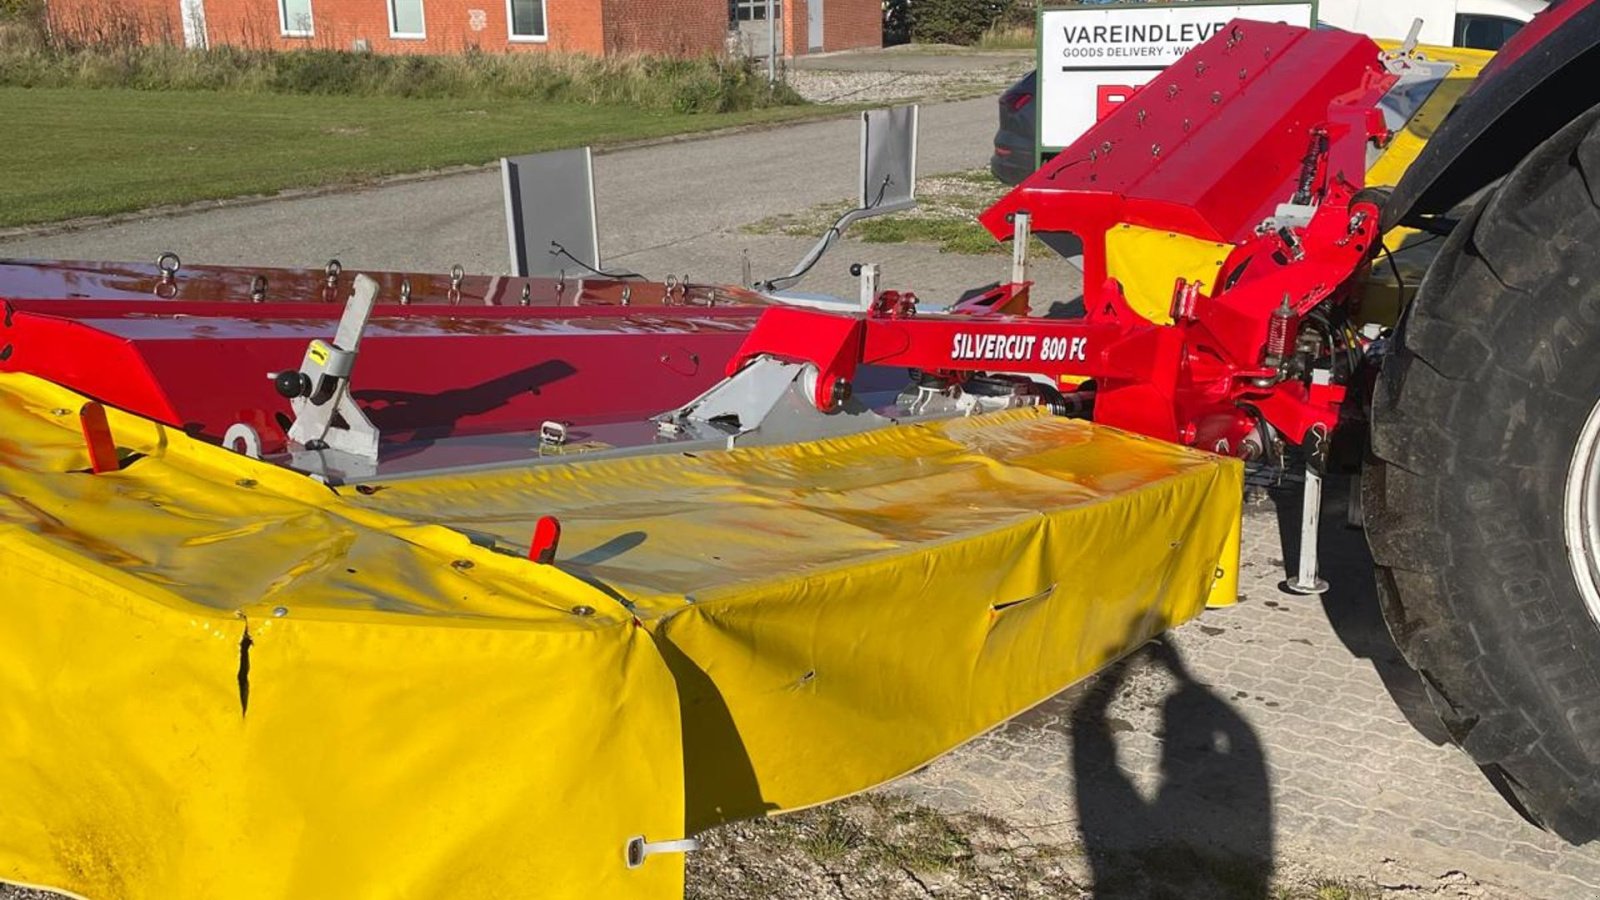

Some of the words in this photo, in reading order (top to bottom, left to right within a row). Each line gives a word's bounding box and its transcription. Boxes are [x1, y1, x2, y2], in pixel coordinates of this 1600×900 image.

[1063, 47, 1104, 58] GOODS
[1107, 47, 1163, 57] DELIVERY
[951, 333, 1036, 360] SILVERCUT
[1040, 337, 1067, 361] 800
[1069, 338, 1087, 361] FC
